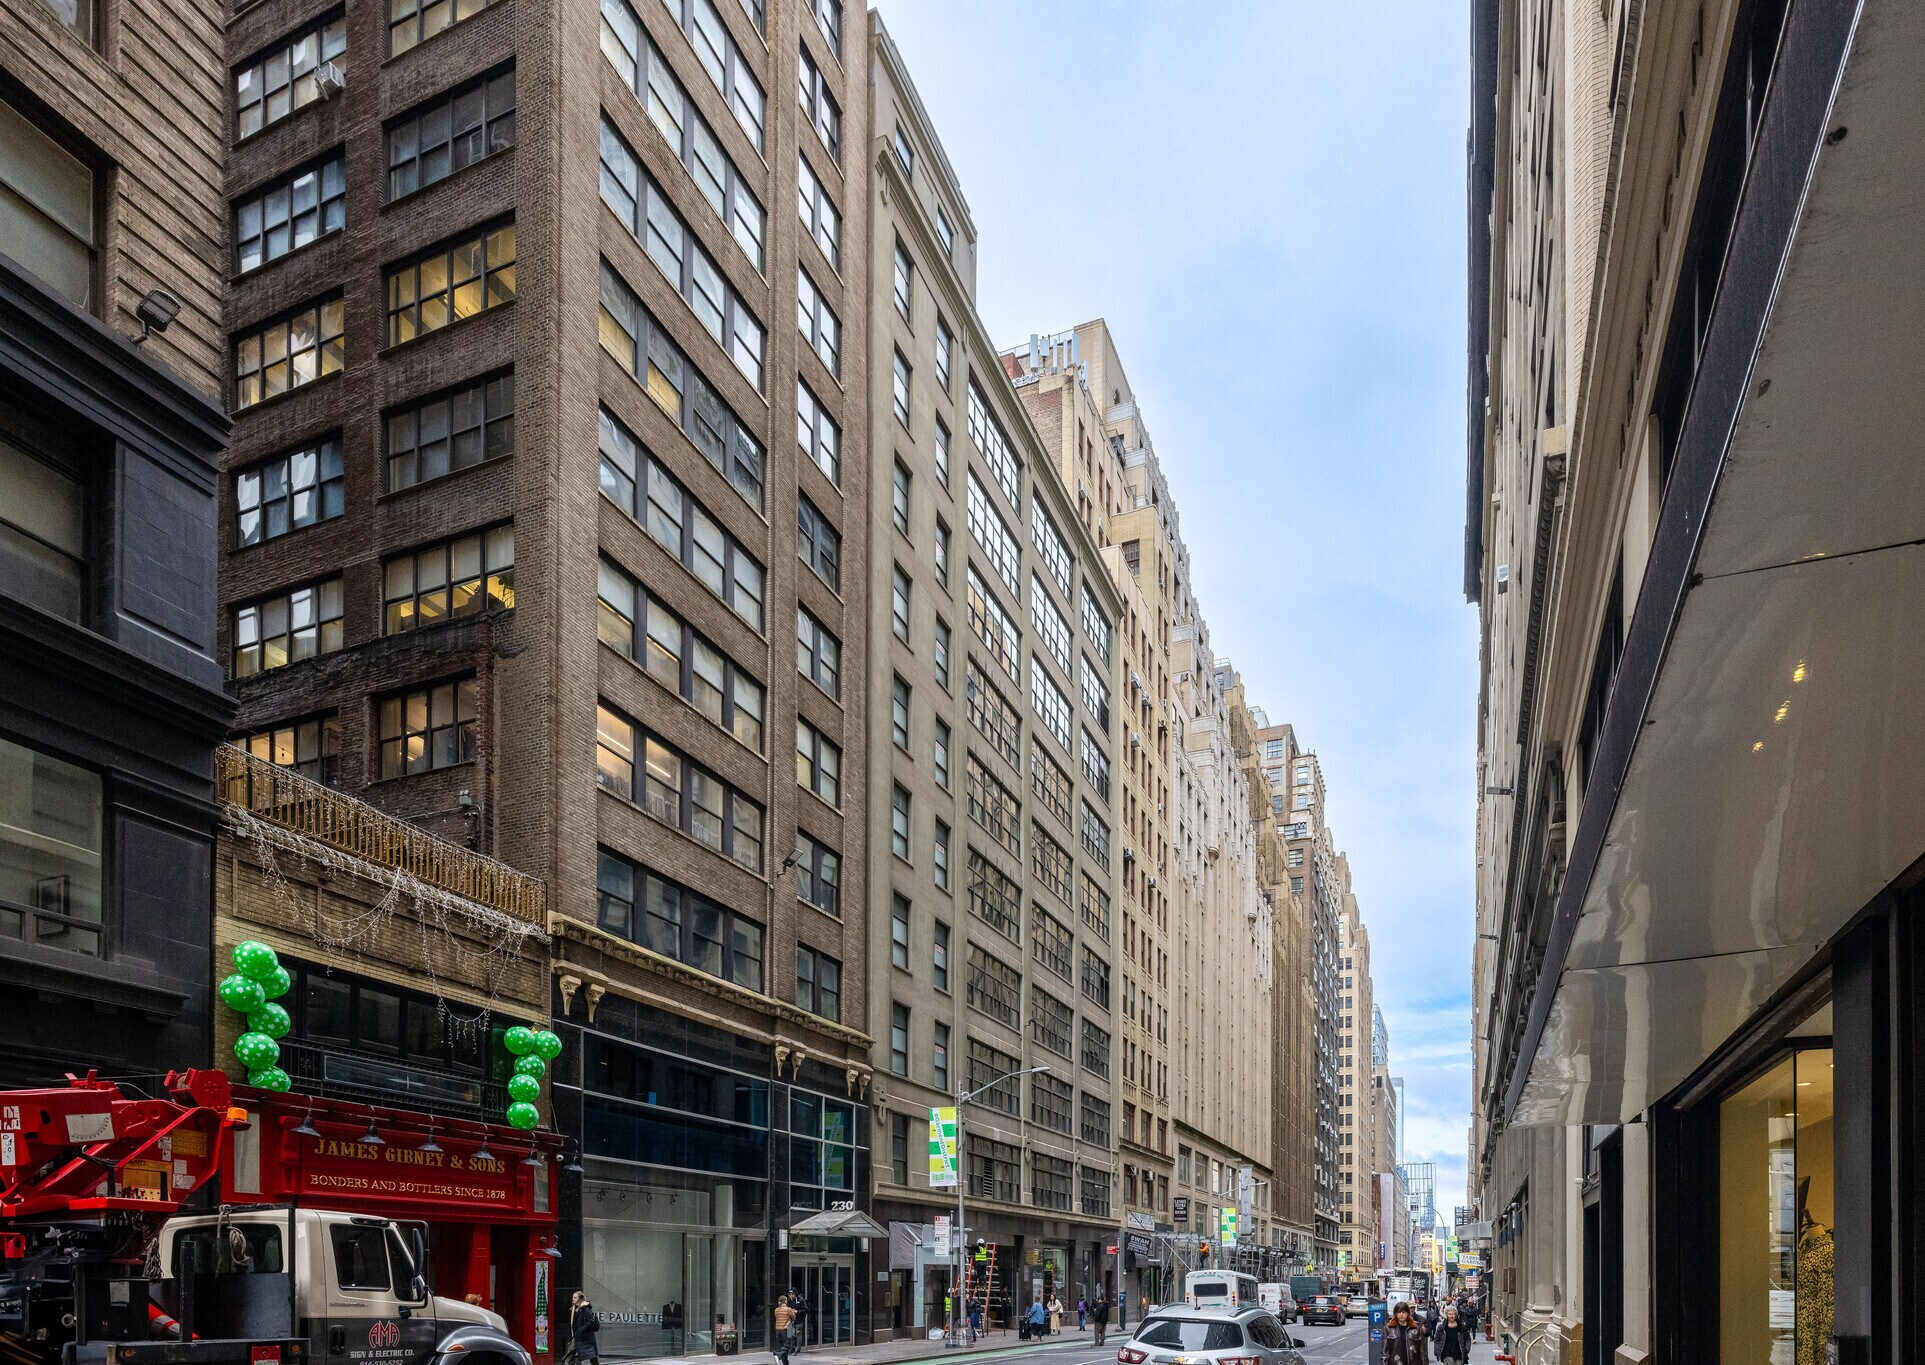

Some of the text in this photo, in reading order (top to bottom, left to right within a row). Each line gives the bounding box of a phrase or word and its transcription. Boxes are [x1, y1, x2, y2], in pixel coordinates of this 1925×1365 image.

[934, 1113, 950, 1168] #GarmentDistrict
[314, 1139, 506, 1174] JAMES GIBNEY & SONS
[310, 1174, 506, 1200] BONDERS AND BOTTLERS SINCE 1878
[831, 1200, 854, 1211] 230
[1130, 1235, 1150, 1245] SWAN
[609, 1312, 663, 1324] PAULETTE
[1374, 1312, 1381, 1323] P
[368, 1320, 400, 1348] AMA
[350, 1348, 414, 1358] SIGN & ELECTRIC CO.
